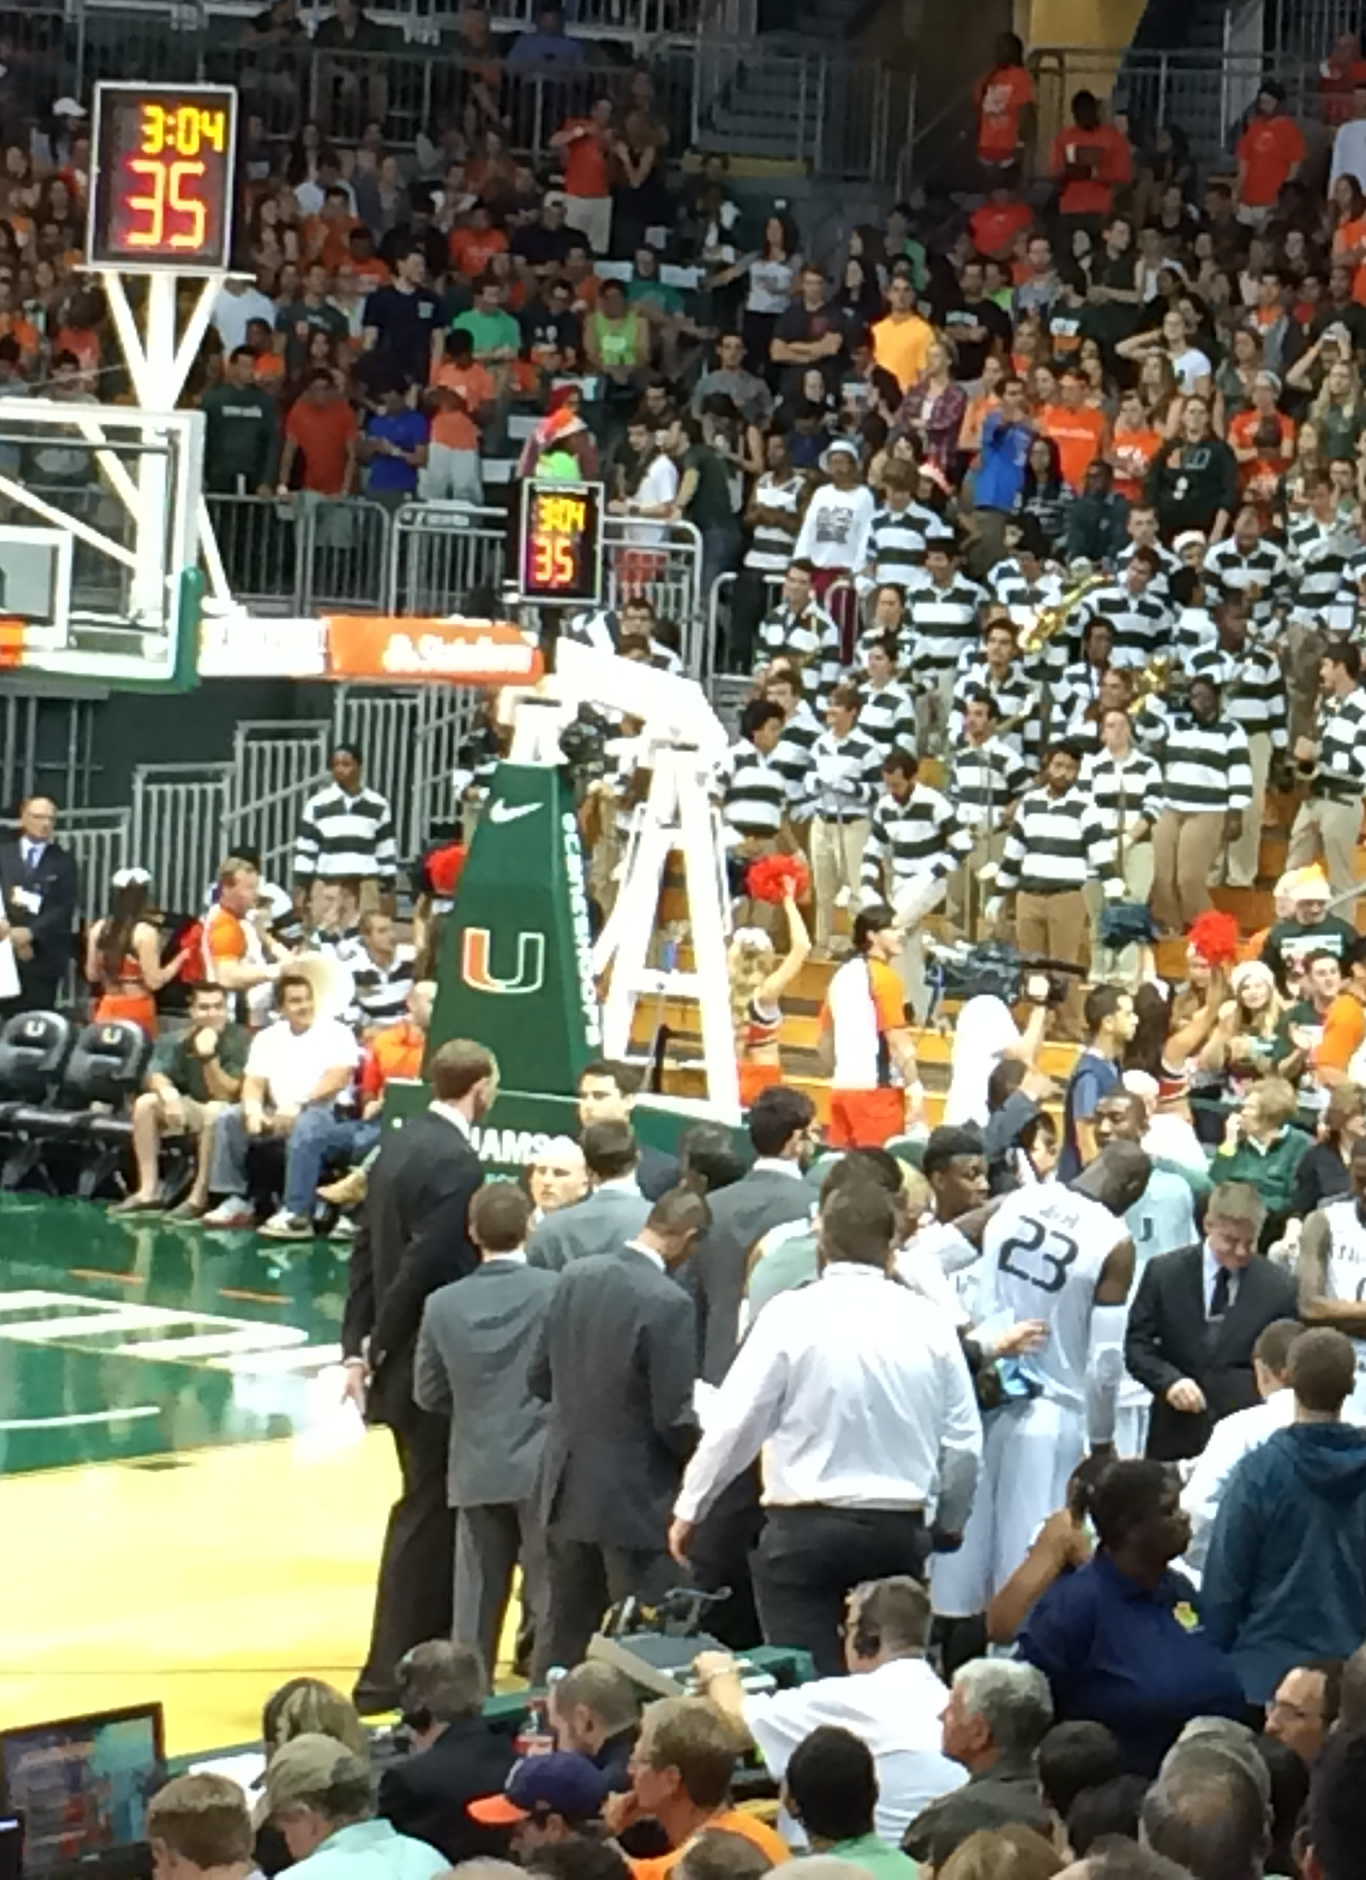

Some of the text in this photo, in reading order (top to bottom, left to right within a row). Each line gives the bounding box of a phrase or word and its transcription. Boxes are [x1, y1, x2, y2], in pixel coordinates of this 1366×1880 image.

[141, 104, 225, 156] 3:04
[126, 159, 206, 248] 35
[535, 537, 575, 583] 35
[463, 927, 545, 993] U
[25, 1019, 47, 1038] U
[101, 1027, 122, 1046] U
[997, 1213, 1079, 1294] 23
